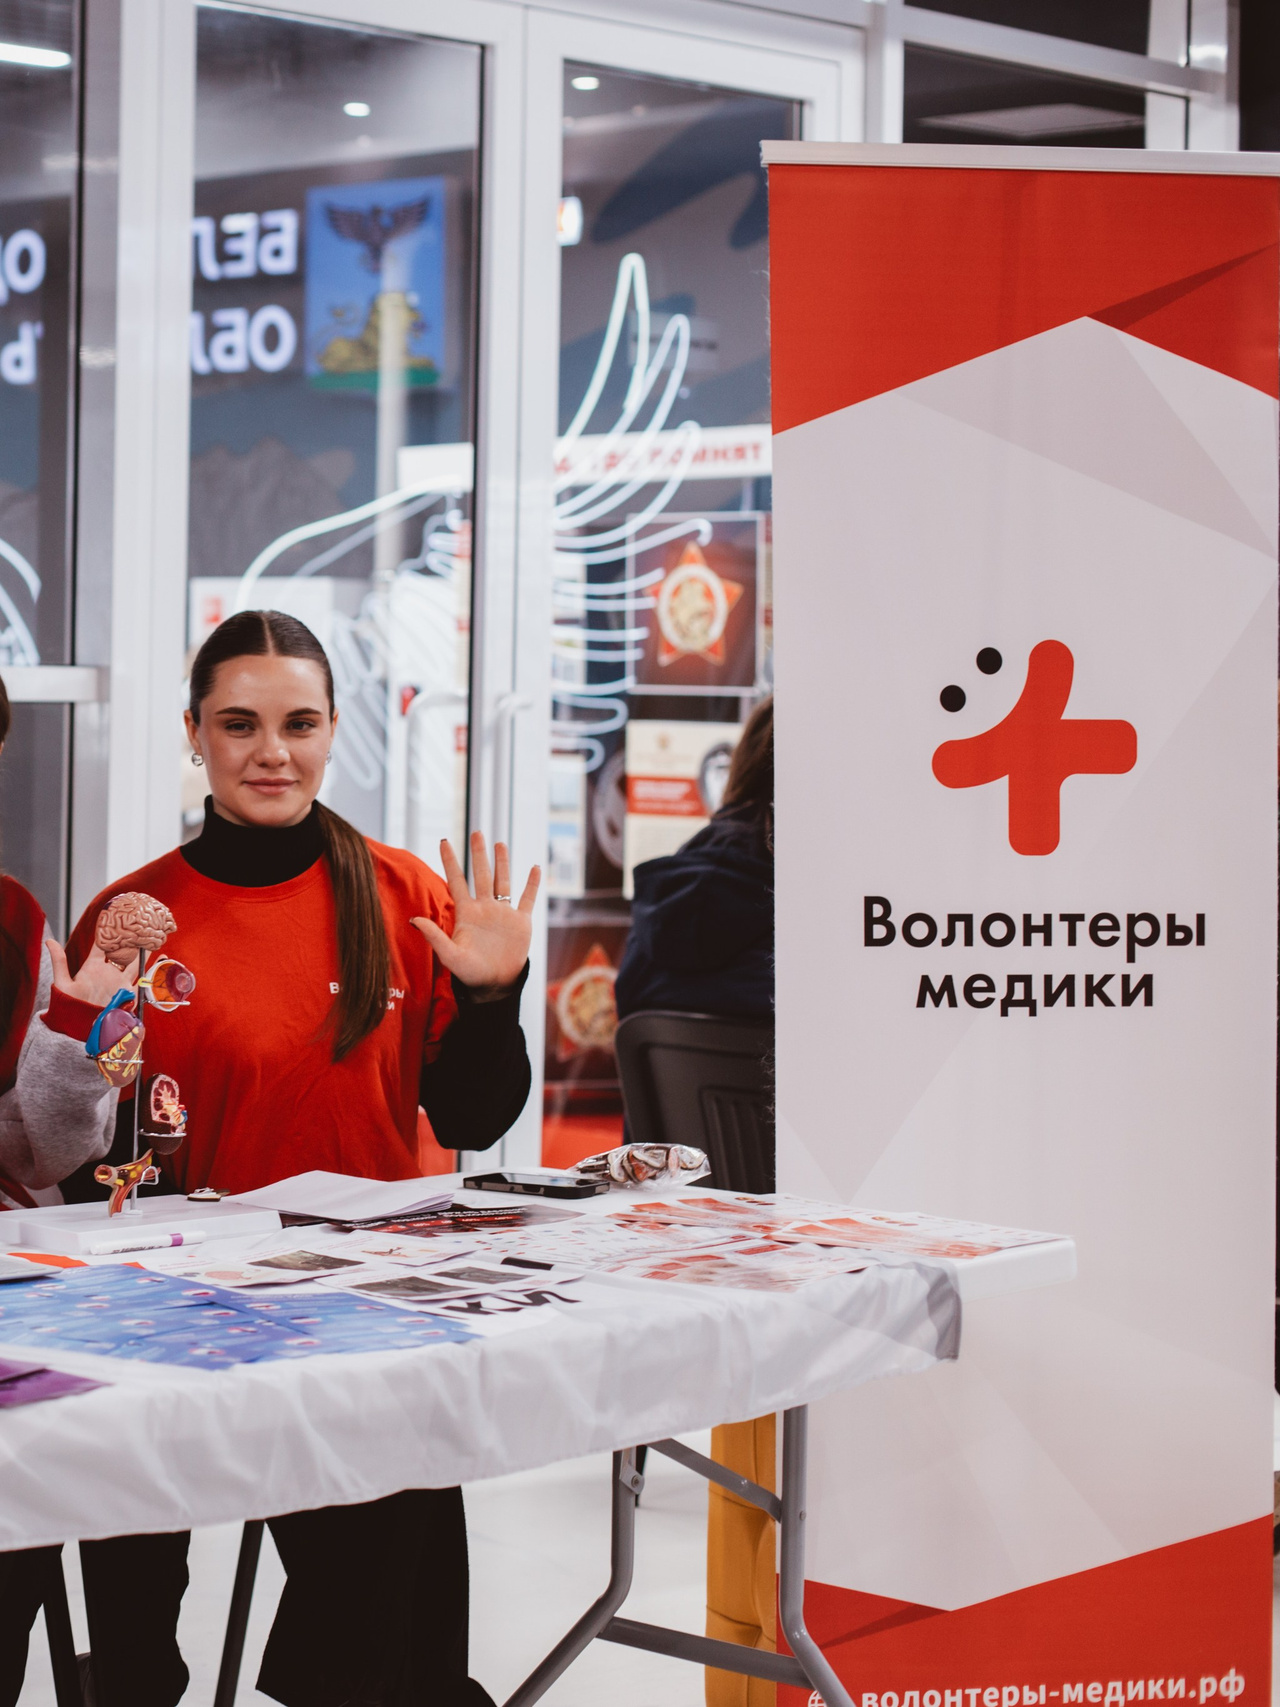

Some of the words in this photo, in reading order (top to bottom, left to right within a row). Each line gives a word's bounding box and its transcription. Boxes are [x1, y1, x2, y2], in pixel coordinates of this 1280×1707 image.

[863, 895, 1206, 964] Волонтеры
[915, 973, 1154, 1017] медики
[861, 1667, 1245, 1707] волонтеры-медики.рф
